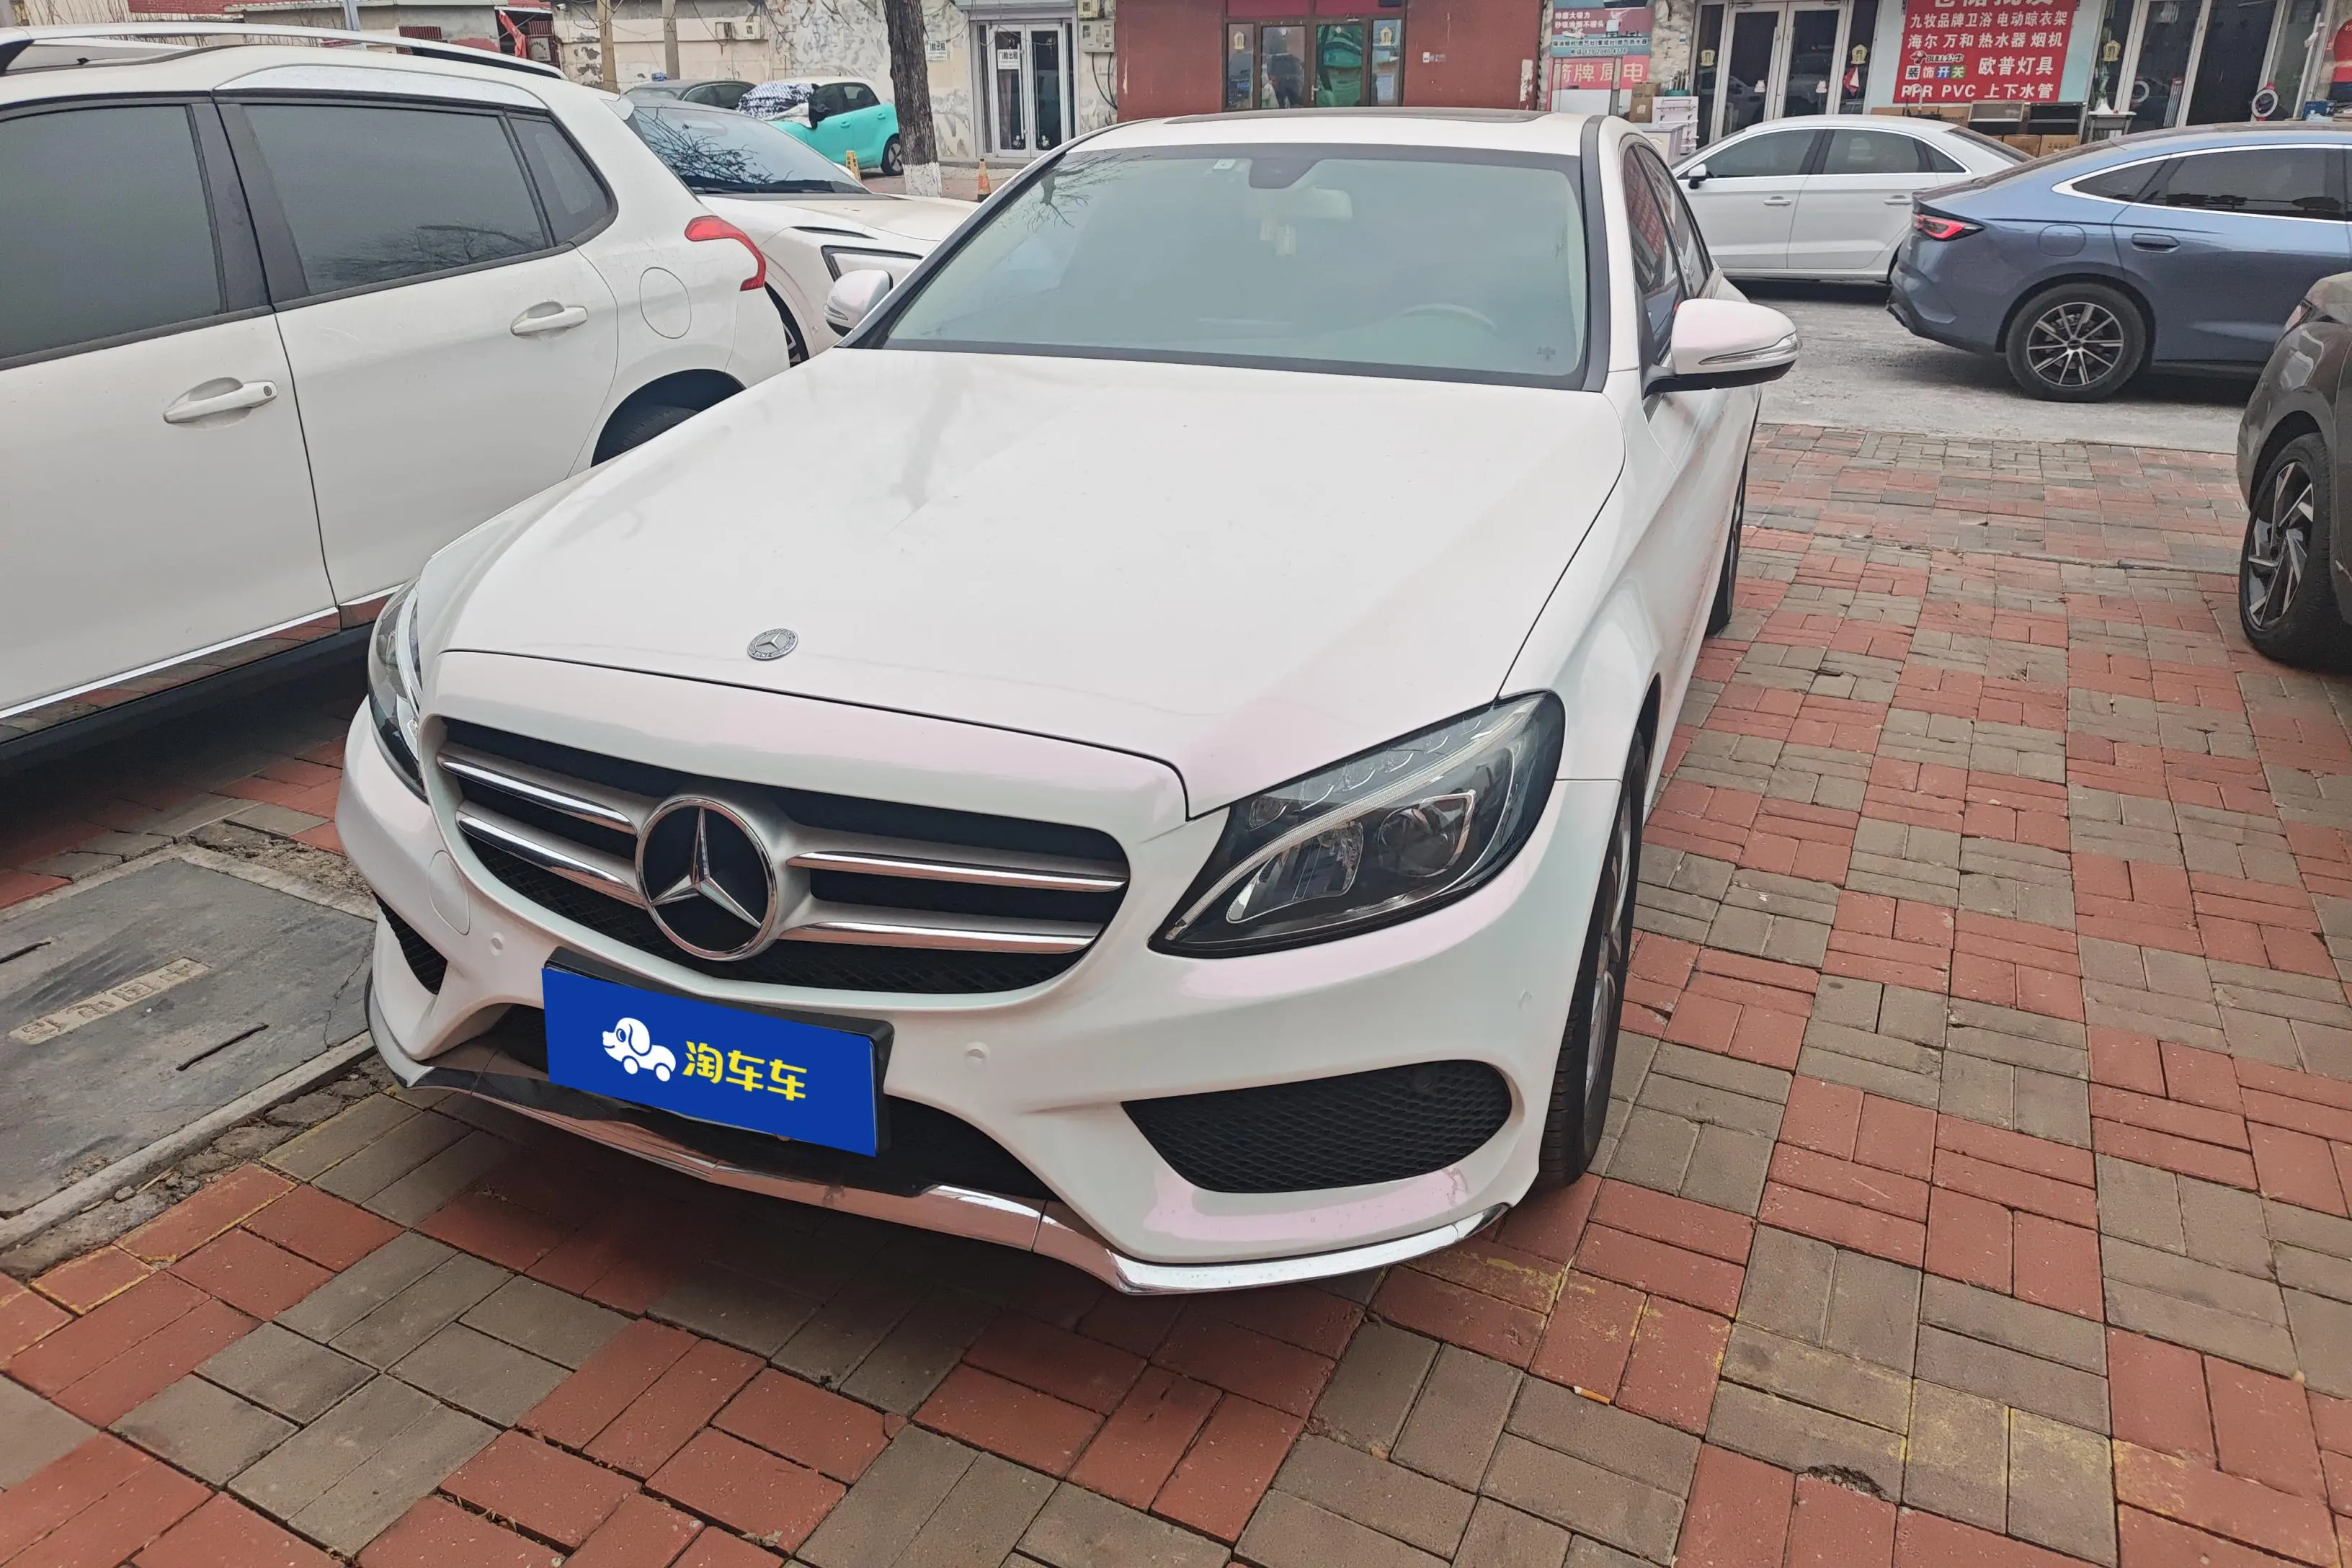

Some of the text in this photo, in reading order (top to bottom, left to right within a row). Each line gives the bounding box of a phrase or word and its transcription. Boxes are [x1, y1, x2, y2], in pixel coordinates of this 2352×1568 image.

[1910, 11, 2067, 28] 九牧品牌卫浴 电动晾衣架
[1908, 32, 2062, 49] 海尔 万和 热水器 烟机
[1906, 56, 2054, 79] 装饰开关 欧普灯具
[1941, 84, 1976, 98] PVC
[1984, 83, 2054, 99] 上下水管
